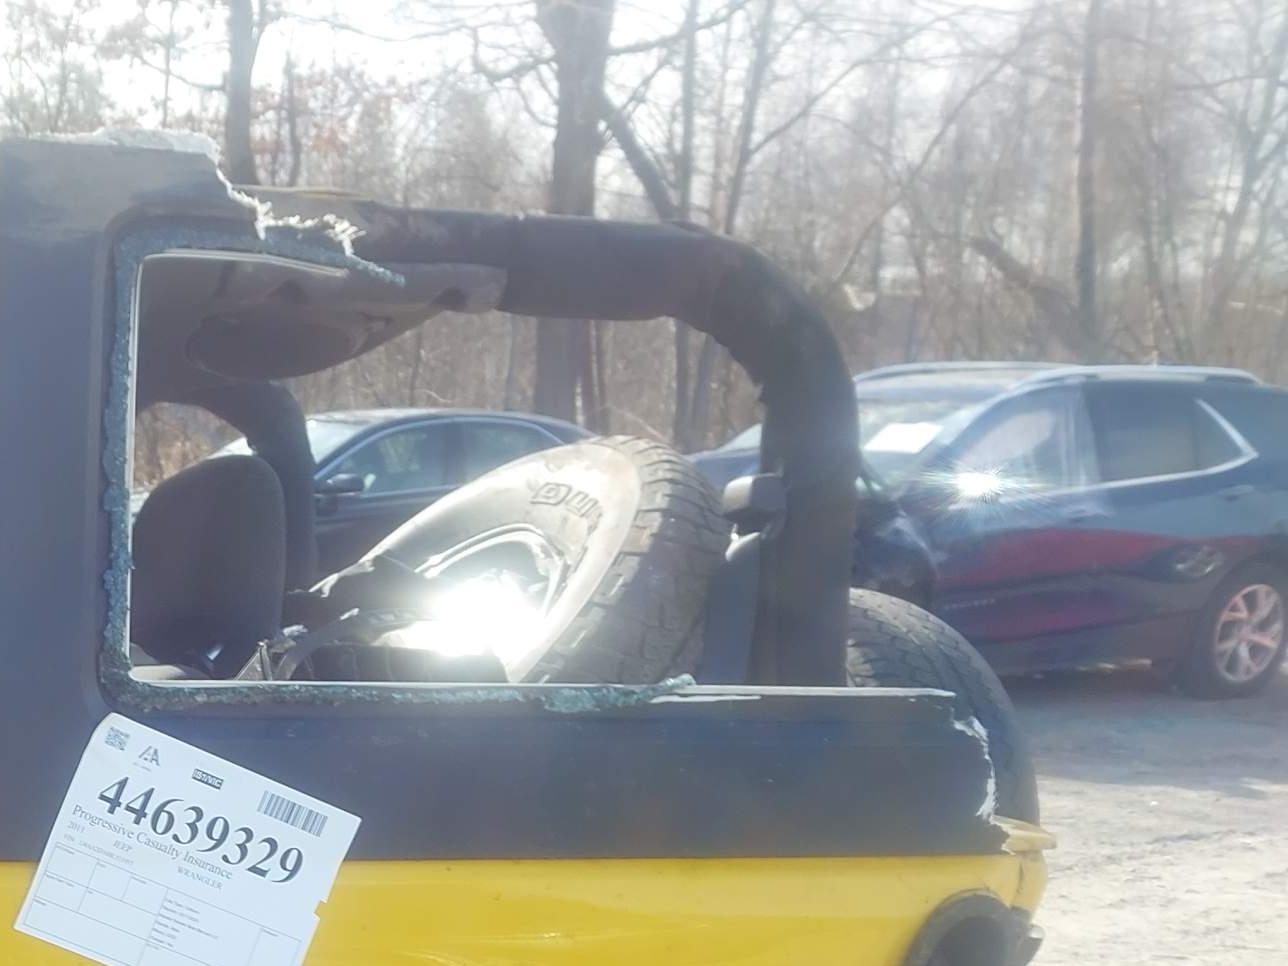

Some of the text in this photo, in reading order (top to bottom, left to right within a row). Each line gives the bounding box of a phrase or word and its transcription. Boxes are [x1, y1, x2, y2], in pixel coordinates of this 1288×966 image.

[73, 804, 135, 839] Progressive
[136, 832, 182, 861] Casualty
[183, 849, 233, 879] Insurance
[98, 776, 304, 883] 44639329
